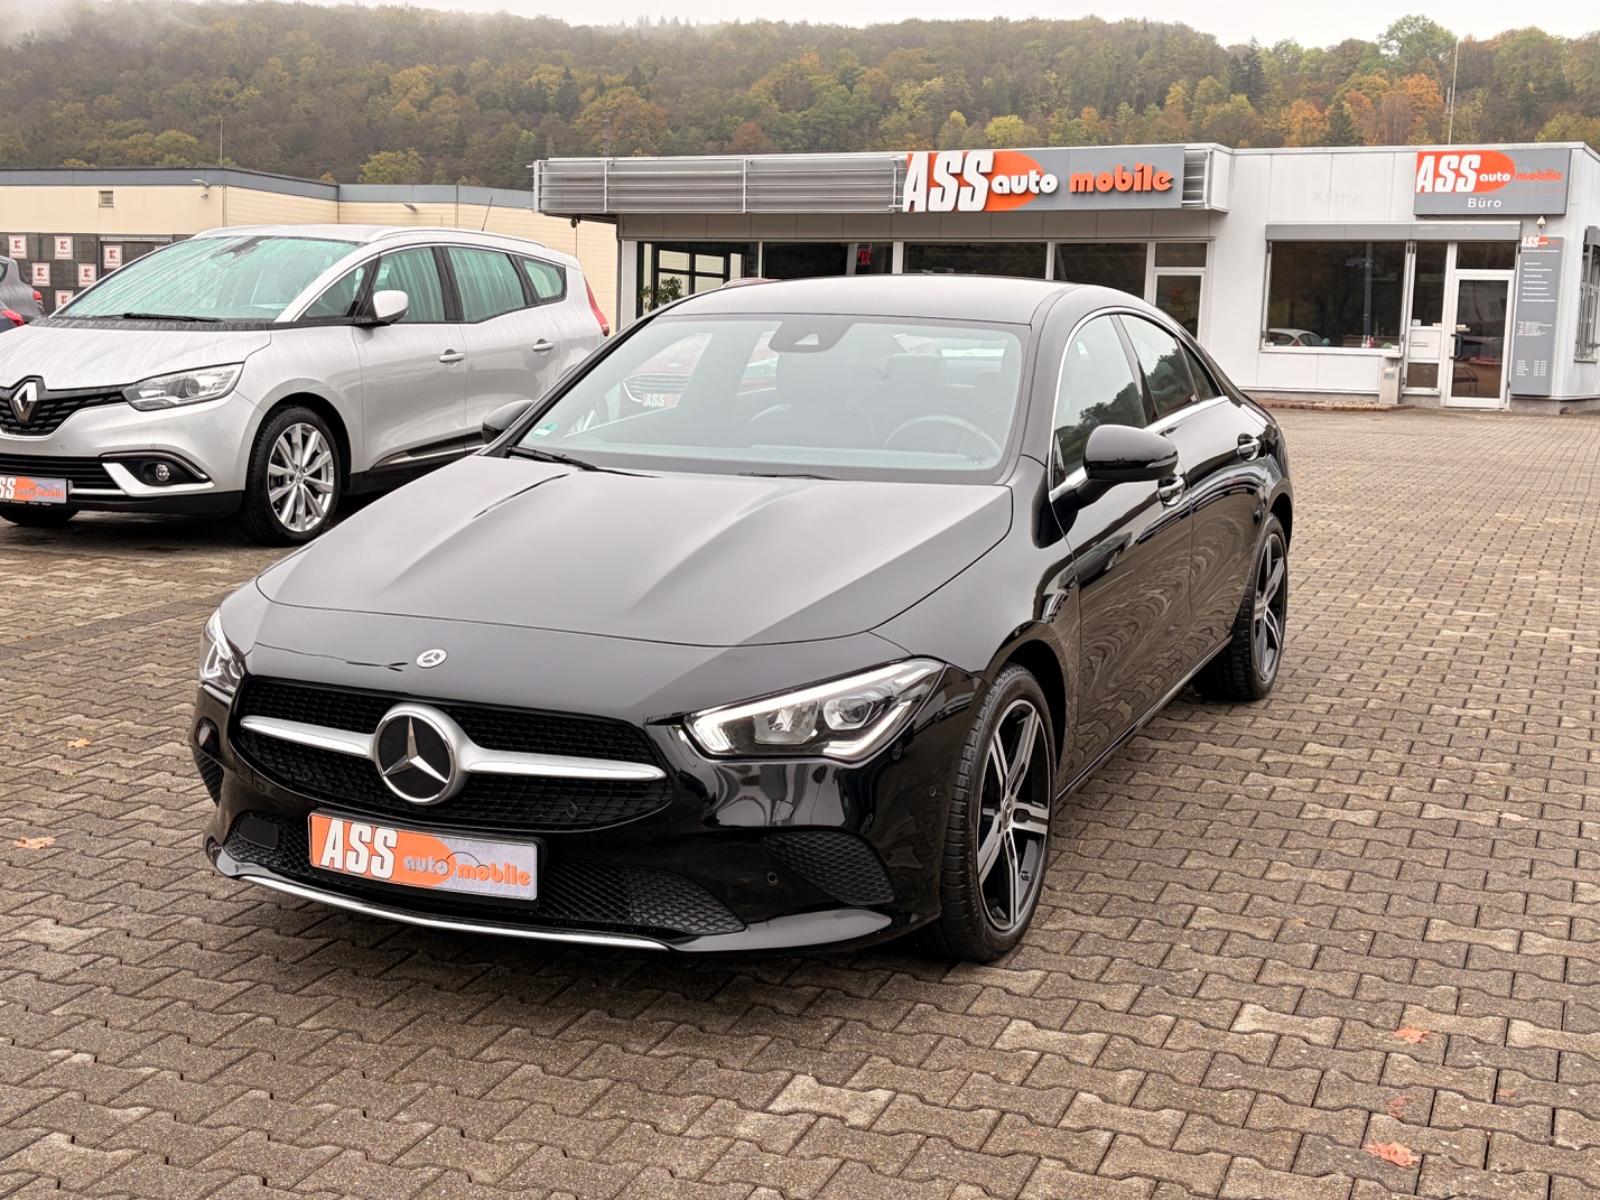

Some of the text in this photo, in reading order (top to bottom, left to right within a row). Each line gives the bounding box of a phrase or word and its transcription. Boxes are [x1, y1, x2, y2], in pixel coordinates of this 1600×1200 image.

[902, 149, 1174, 213] ASS auto mobile
[1416, 154, 1481, 193] ASS
[1479, 171, 1511, 183] auto
[1467, 197, 1502, 208] Büro
[320, 818, 532, 887] ASS auto mobile
